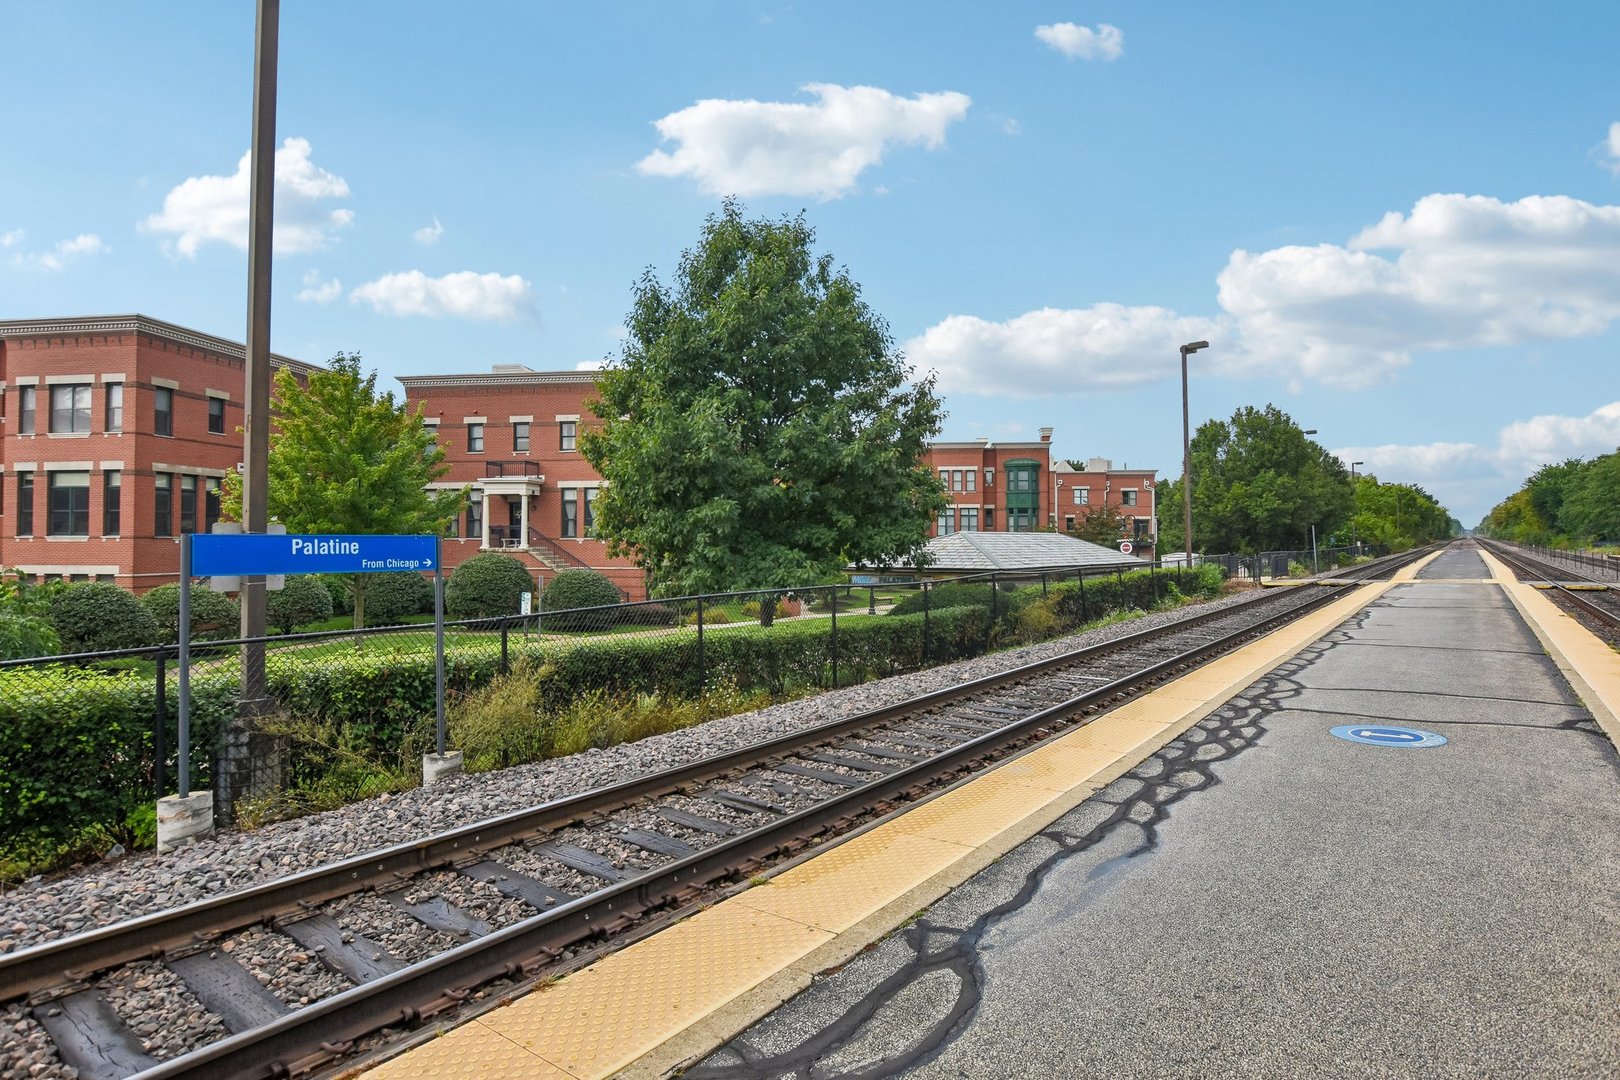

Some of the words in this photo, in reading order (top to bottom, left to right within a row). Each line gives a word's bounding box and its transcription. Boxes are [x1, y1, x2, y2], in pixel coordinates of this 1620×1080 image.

[291, 538, 360, 555] Palatine
[362, 559, 384, 568] From
[386, 558, 419, 569] Chicago
